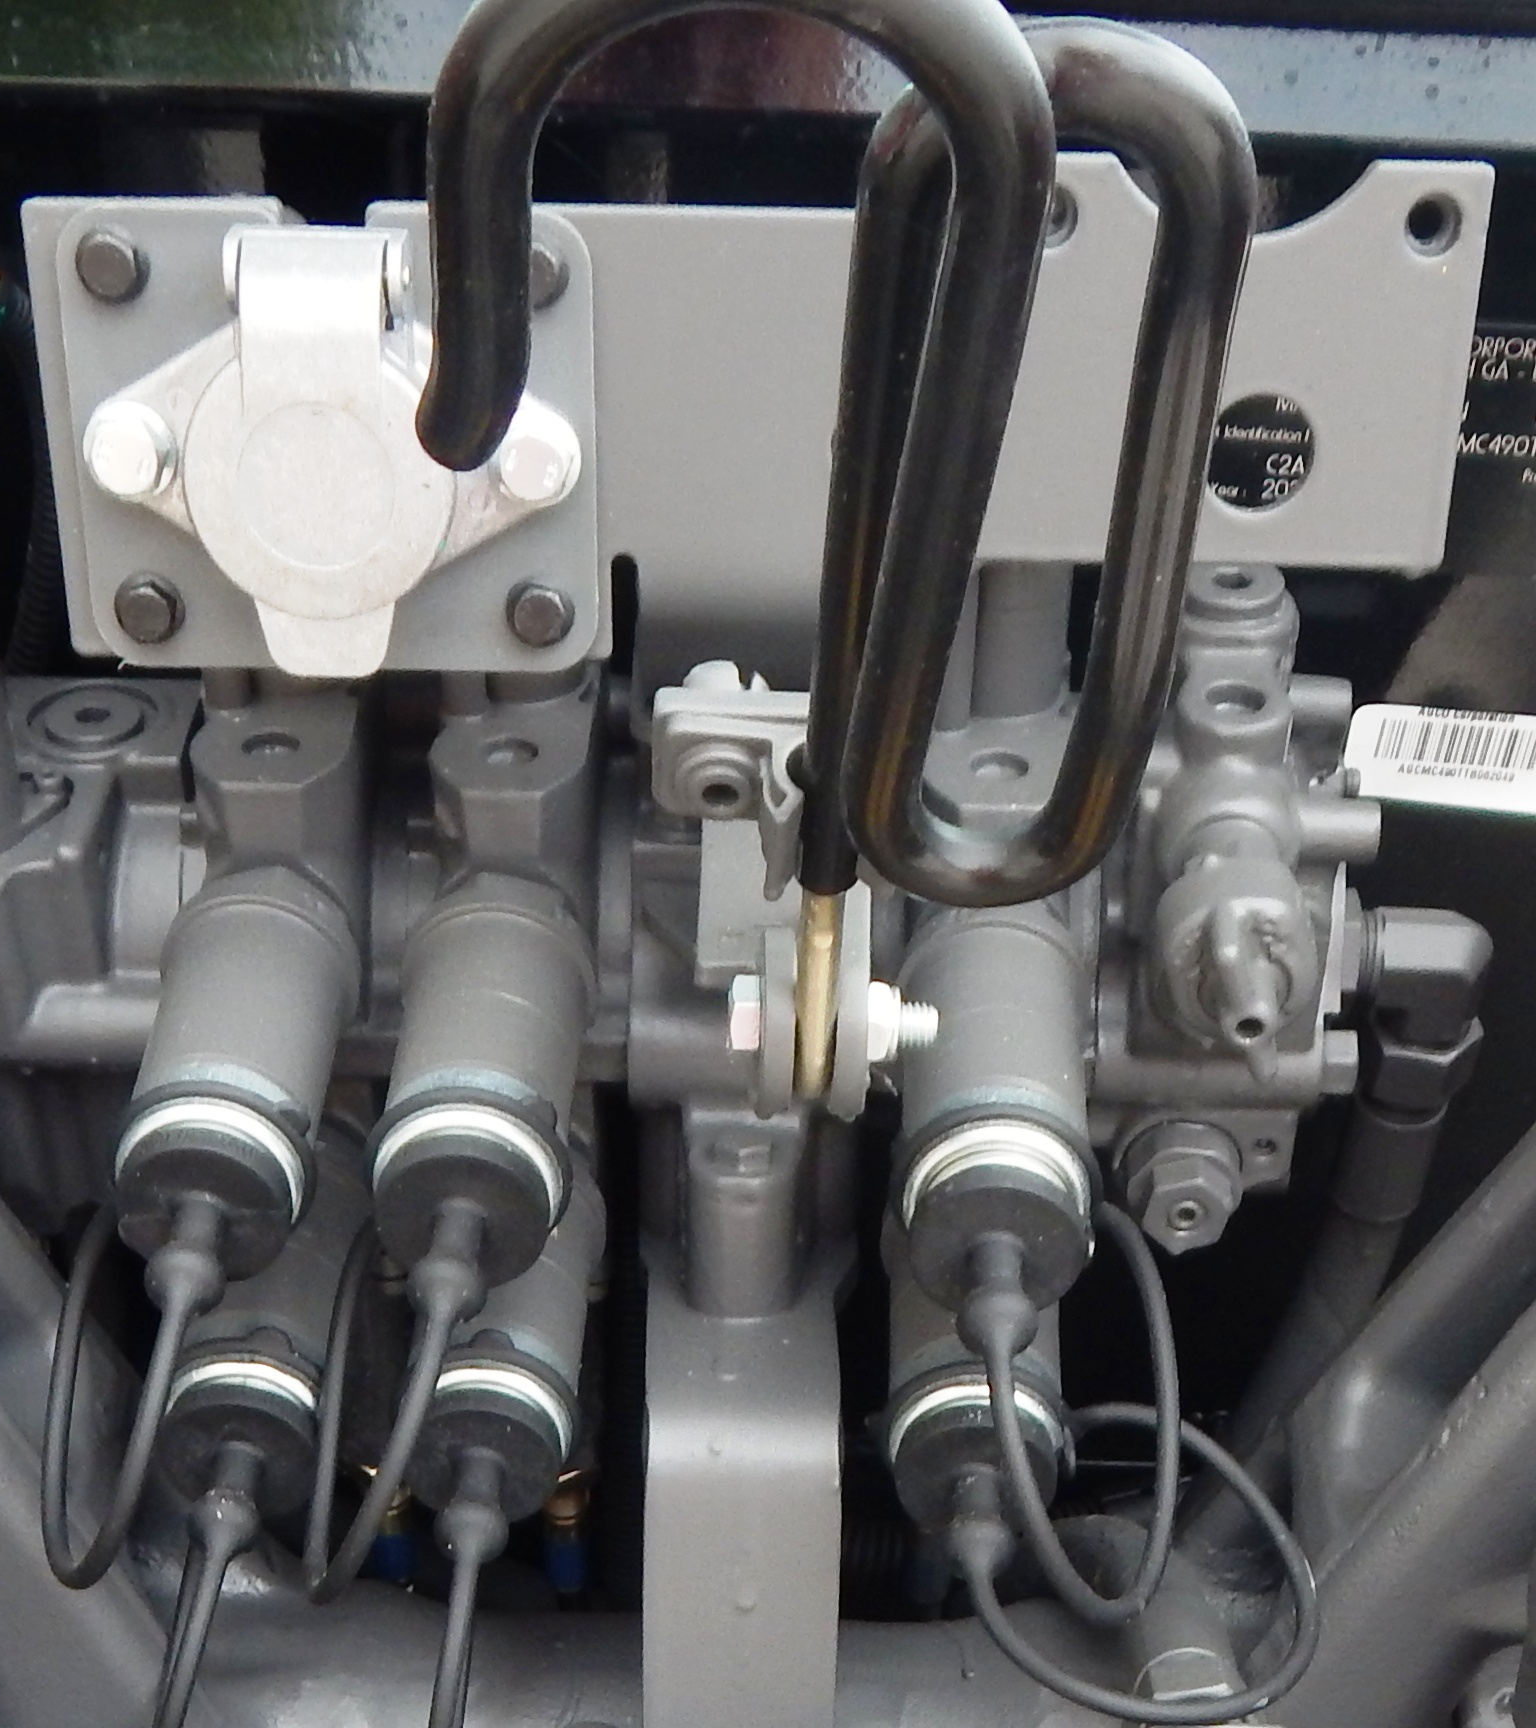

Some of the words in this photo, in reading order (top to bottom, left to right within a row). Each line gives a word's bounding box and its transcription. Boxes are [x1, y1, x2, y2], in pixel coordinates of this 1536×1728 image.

[1482, 359, 1510, 382] GA
[1223, 423, 1302, 443] Identification
[1265, 452, 1305, 476] C2A
